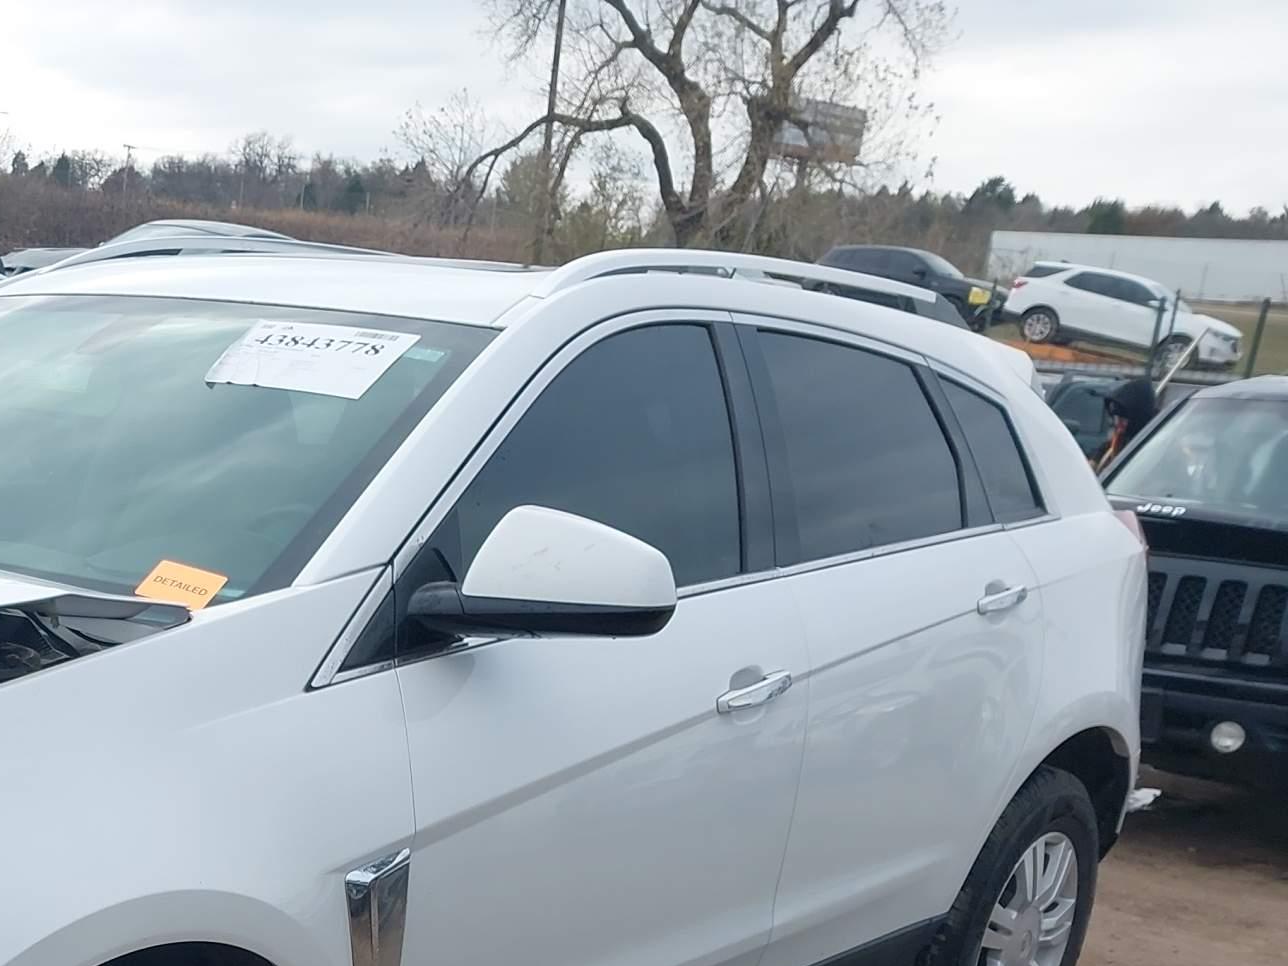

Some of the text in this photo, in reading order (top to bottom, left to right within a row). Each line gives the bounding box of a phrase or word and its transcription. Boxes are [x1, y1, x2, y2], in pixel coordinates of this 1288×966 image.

[255, 334, 385, 356] 43843778
[1136, 503, 1186, 517] Jeep
[153, 575, 209, 596] DETAILED
